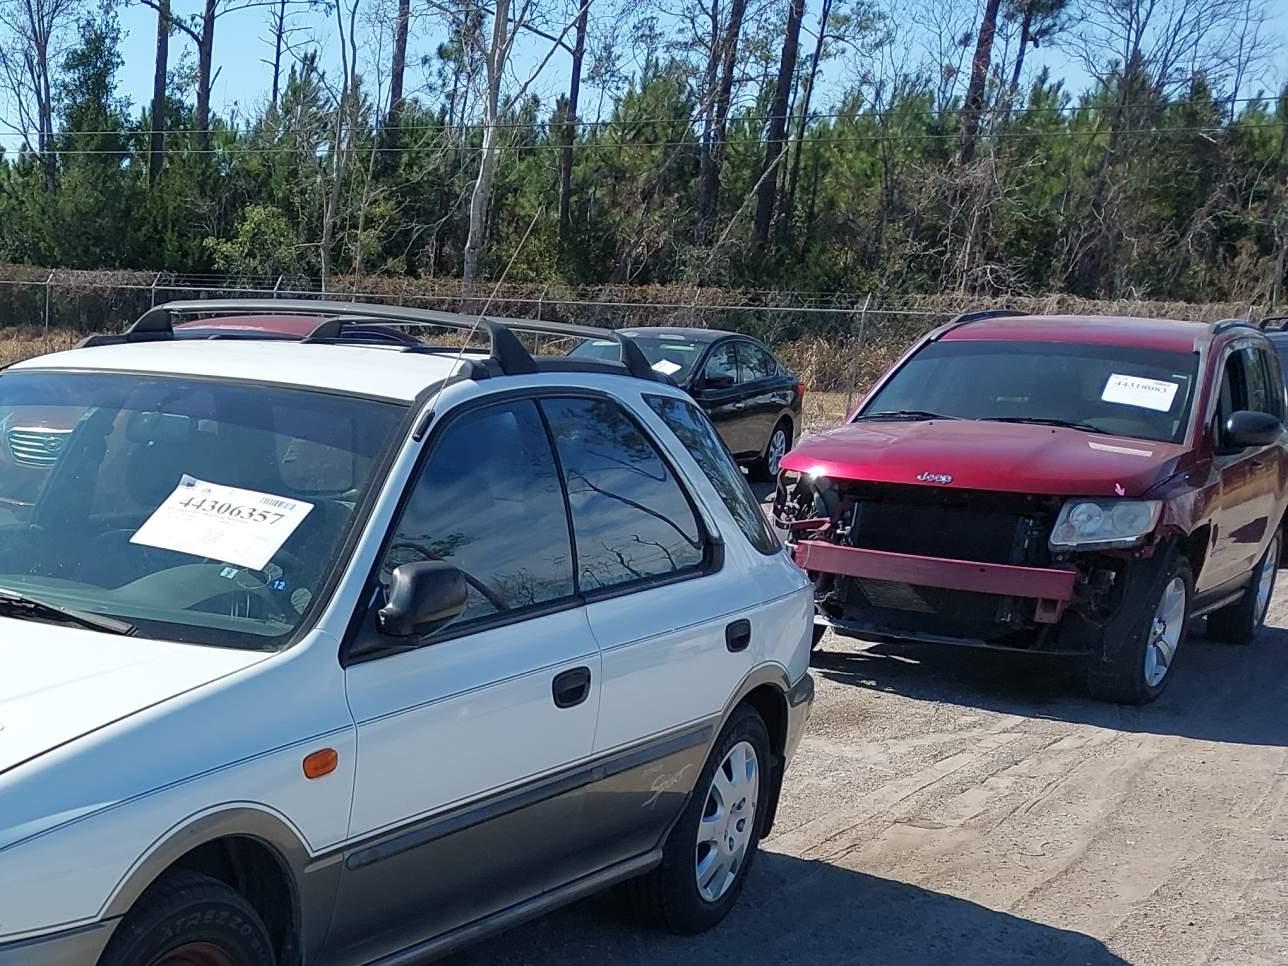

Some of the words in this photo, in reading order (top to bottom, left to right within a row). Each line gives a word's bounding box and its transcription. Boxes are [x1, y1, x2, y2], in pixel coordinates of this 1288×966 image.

[916, 471, 953, 484] Jeep
[179, 496, 286, 525] 44306357
[273, 580, 286, 590] 12
